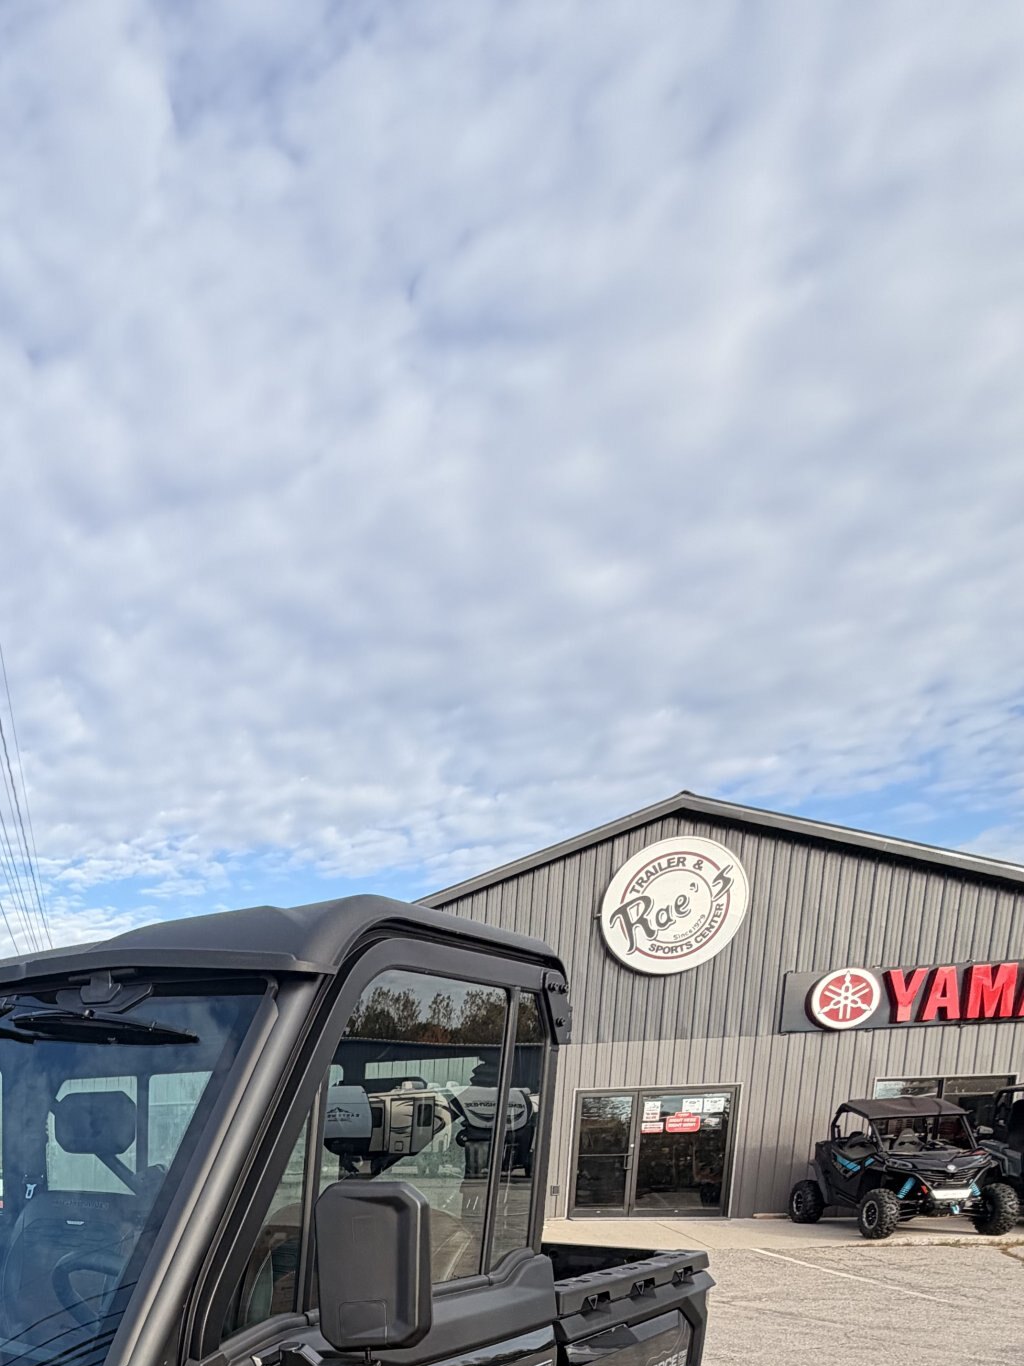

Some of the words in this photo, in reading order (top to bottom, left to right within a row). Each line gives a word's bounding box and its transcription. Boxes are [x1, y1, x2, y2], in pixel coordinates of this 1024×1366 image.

[629, 856, 687, 895] TRAILER
[692, 859, 704, 872] &
[609, 864, 734, 955] Rae's
[648, 942, 694, 955] SPORTS
[694, 902, 724, 944] CENTER
[886, 962, 1024, 1022] YAM
